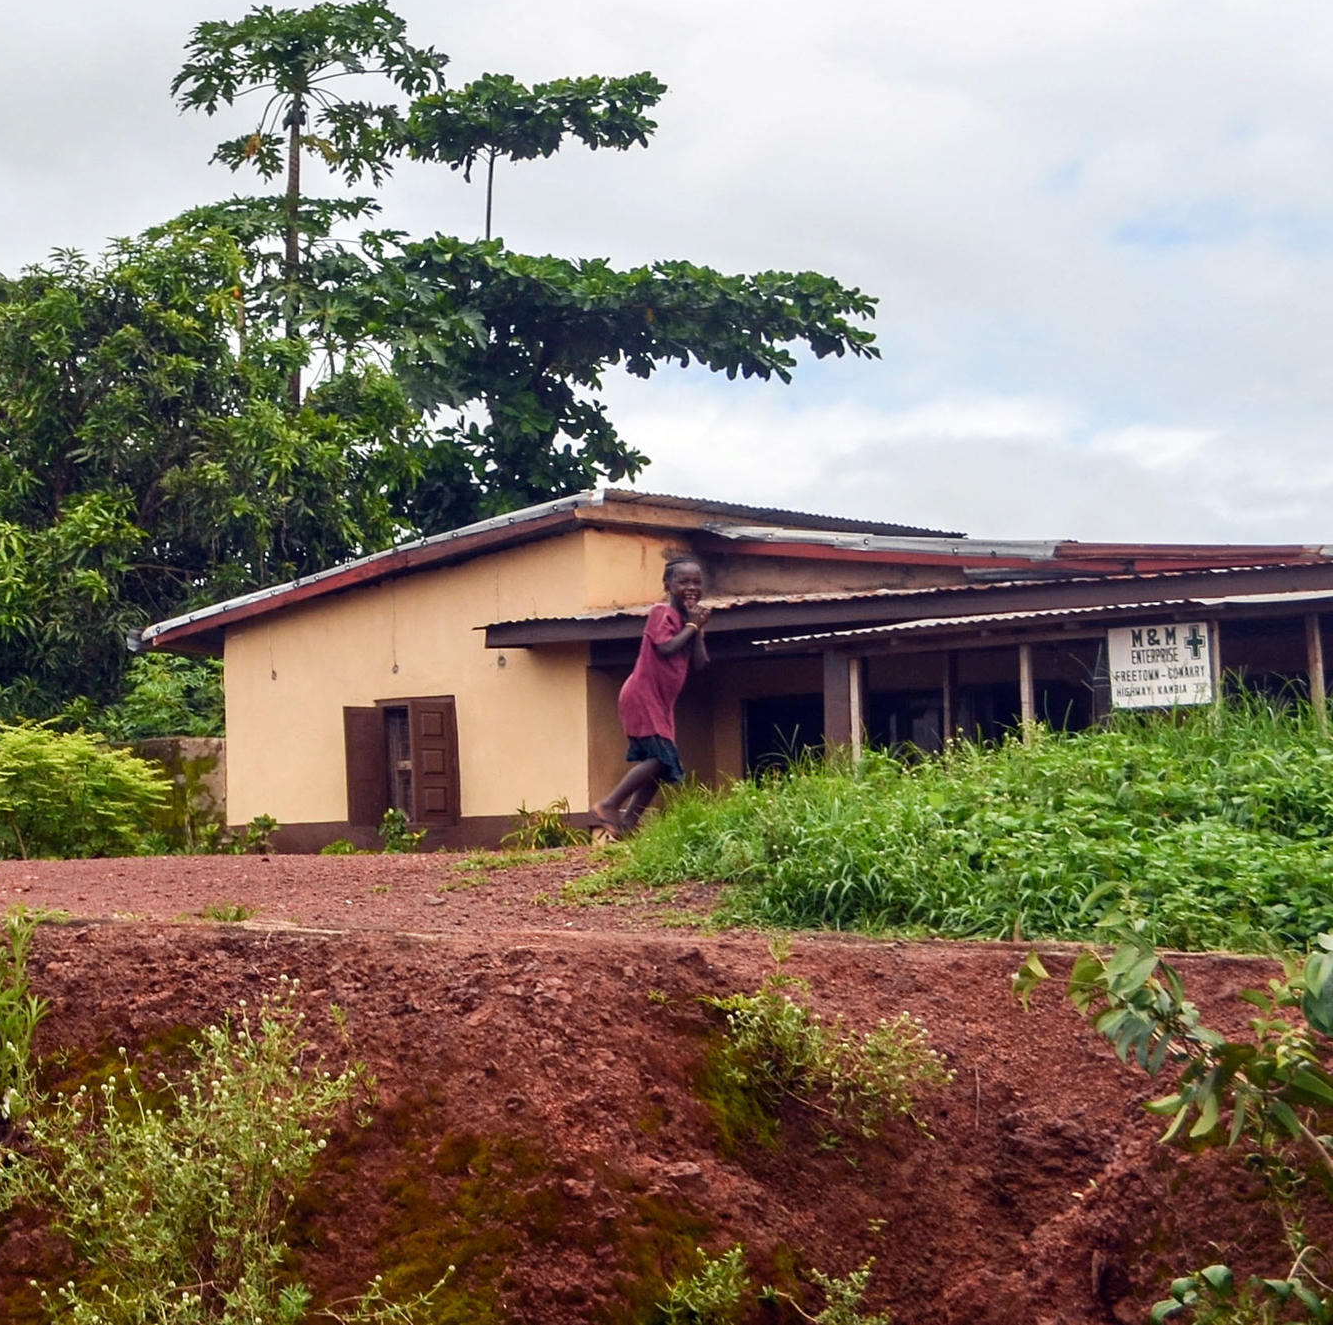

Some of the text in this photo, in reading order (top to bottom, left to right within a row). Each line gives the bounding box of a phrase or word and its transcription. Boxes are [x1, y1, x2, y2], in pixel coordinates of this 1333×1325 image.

[1131, 626, 1177, 647] M & M
[1131, 647, 1179, 665] ENTERPRISE
[1115, 669, 1159, 682] FREETOWN
